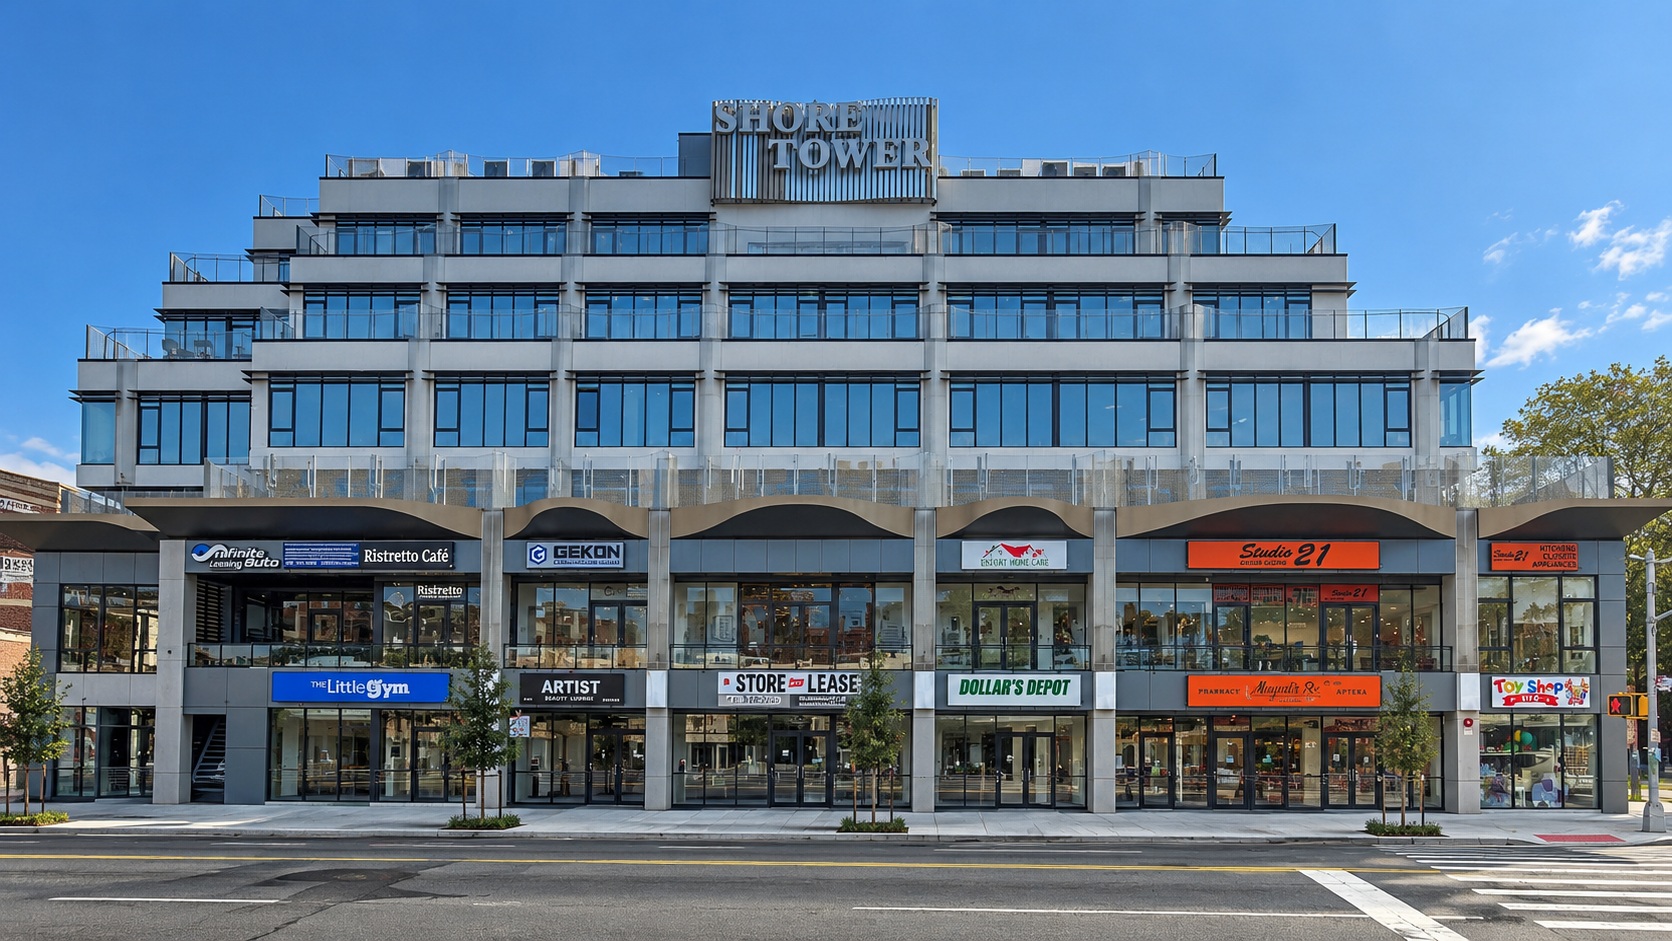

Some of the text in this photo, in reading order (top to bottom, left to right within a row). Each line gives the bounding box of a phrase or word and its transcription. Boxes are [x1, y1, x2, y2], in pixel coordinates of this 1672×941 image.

[714, 101, 864, 134] SHORE
[767, 137, 933, 170] TOWER
[363, 548, 418, 563] Ristretto
[421, 548, 449, 563] Café
[553, 545, 620, 559] GEKON
[1239, 543, 1331, 566] Studio 21
[327, 679, 366, 694] Little
[366, 679, 410, 699] gym
[541, 680, 601, 694] ARTIST
[736, 674, 786, 693] STORE
[807, 674, 858, 693] LEASE
[959, 679, 1071, 695] DOLLAR'S DEPOT
[1493, 679, 1564, 695] Toy Shop
